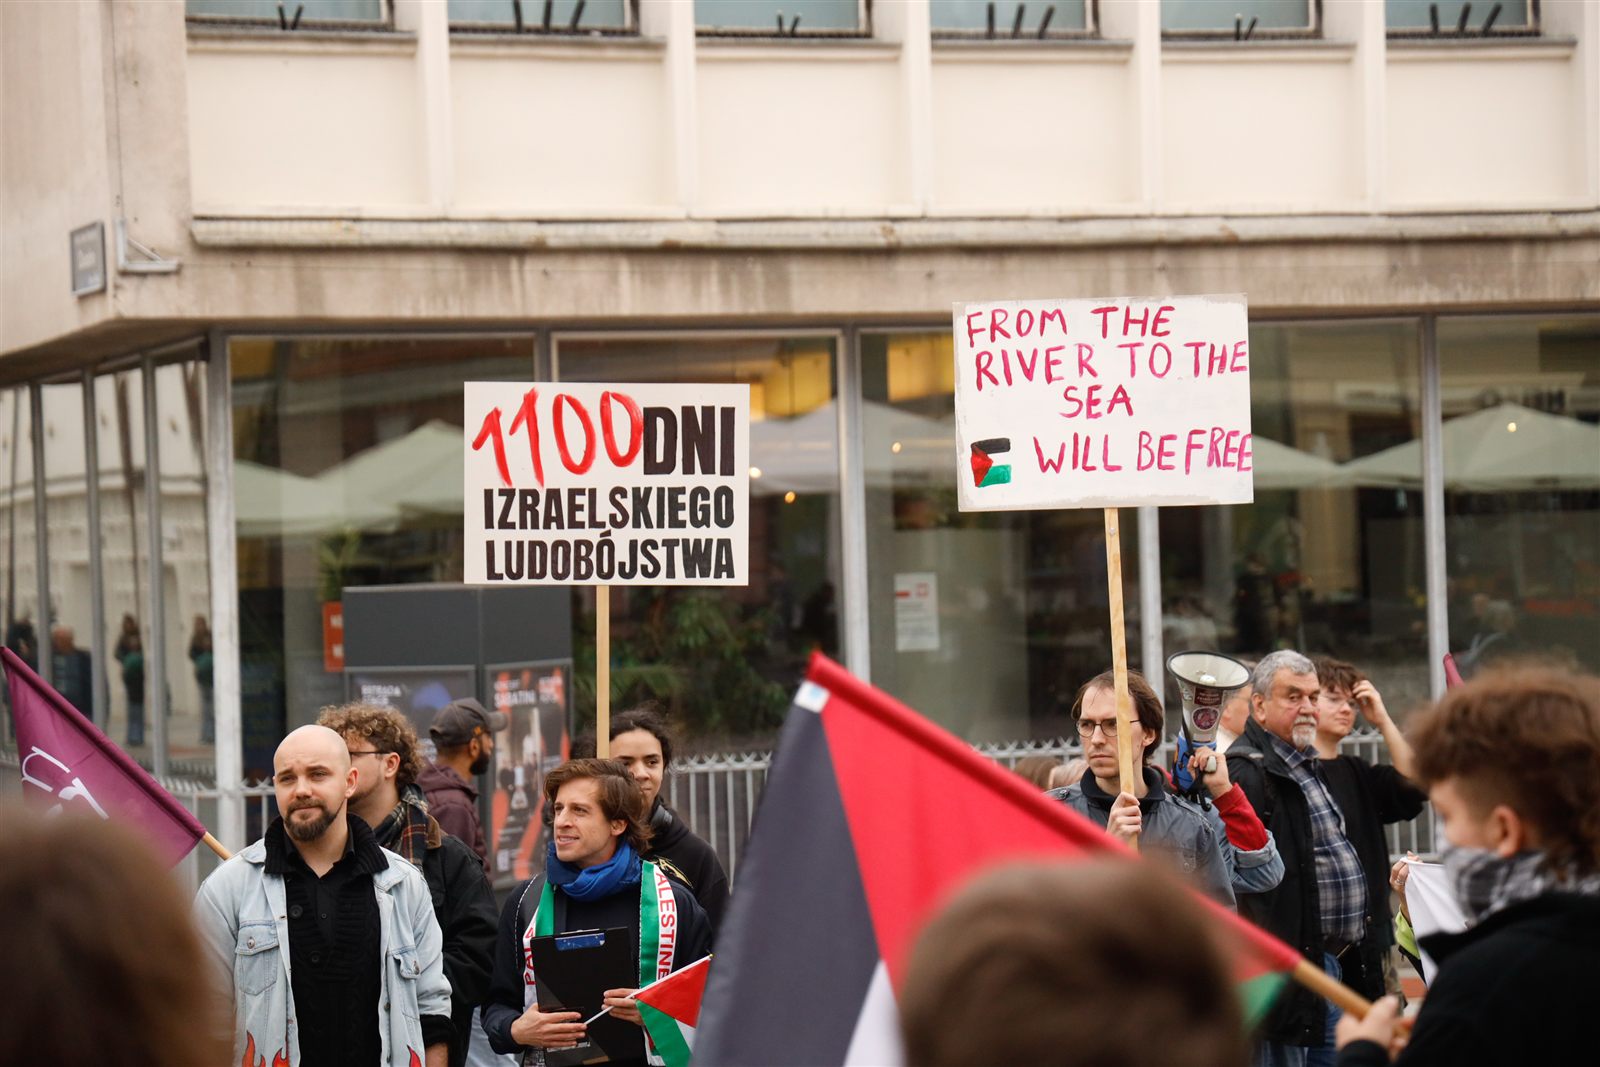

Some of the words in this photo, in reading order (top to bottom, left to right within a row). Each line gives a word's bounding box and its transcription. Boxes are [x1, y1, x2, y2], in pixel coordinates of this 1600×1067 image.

[967, 308, 1067, 348] FROM
[1091, 305, 1176, 339] THE
[975, 343, 1098, 391] RIVER
[1117, 341, 1172, 379] TO
[1184, 340, 1248, 377] THE
[1059, 383, 1134, 420] SEA
[472, 387, 644, 487] 1100
[642, 405, 735, 476] DNI
[1033, 432, 1122, 474] WILL
[1136, 430, 1178, 472] BE
[1185, 427, 1252, 476] FREE
[484, 486, 735, 530] IZRAELSKIEGO
[486, 529, 735, 581] LUDOBÓJSTWA
[655, 871, 676, 981] ALESTINE
